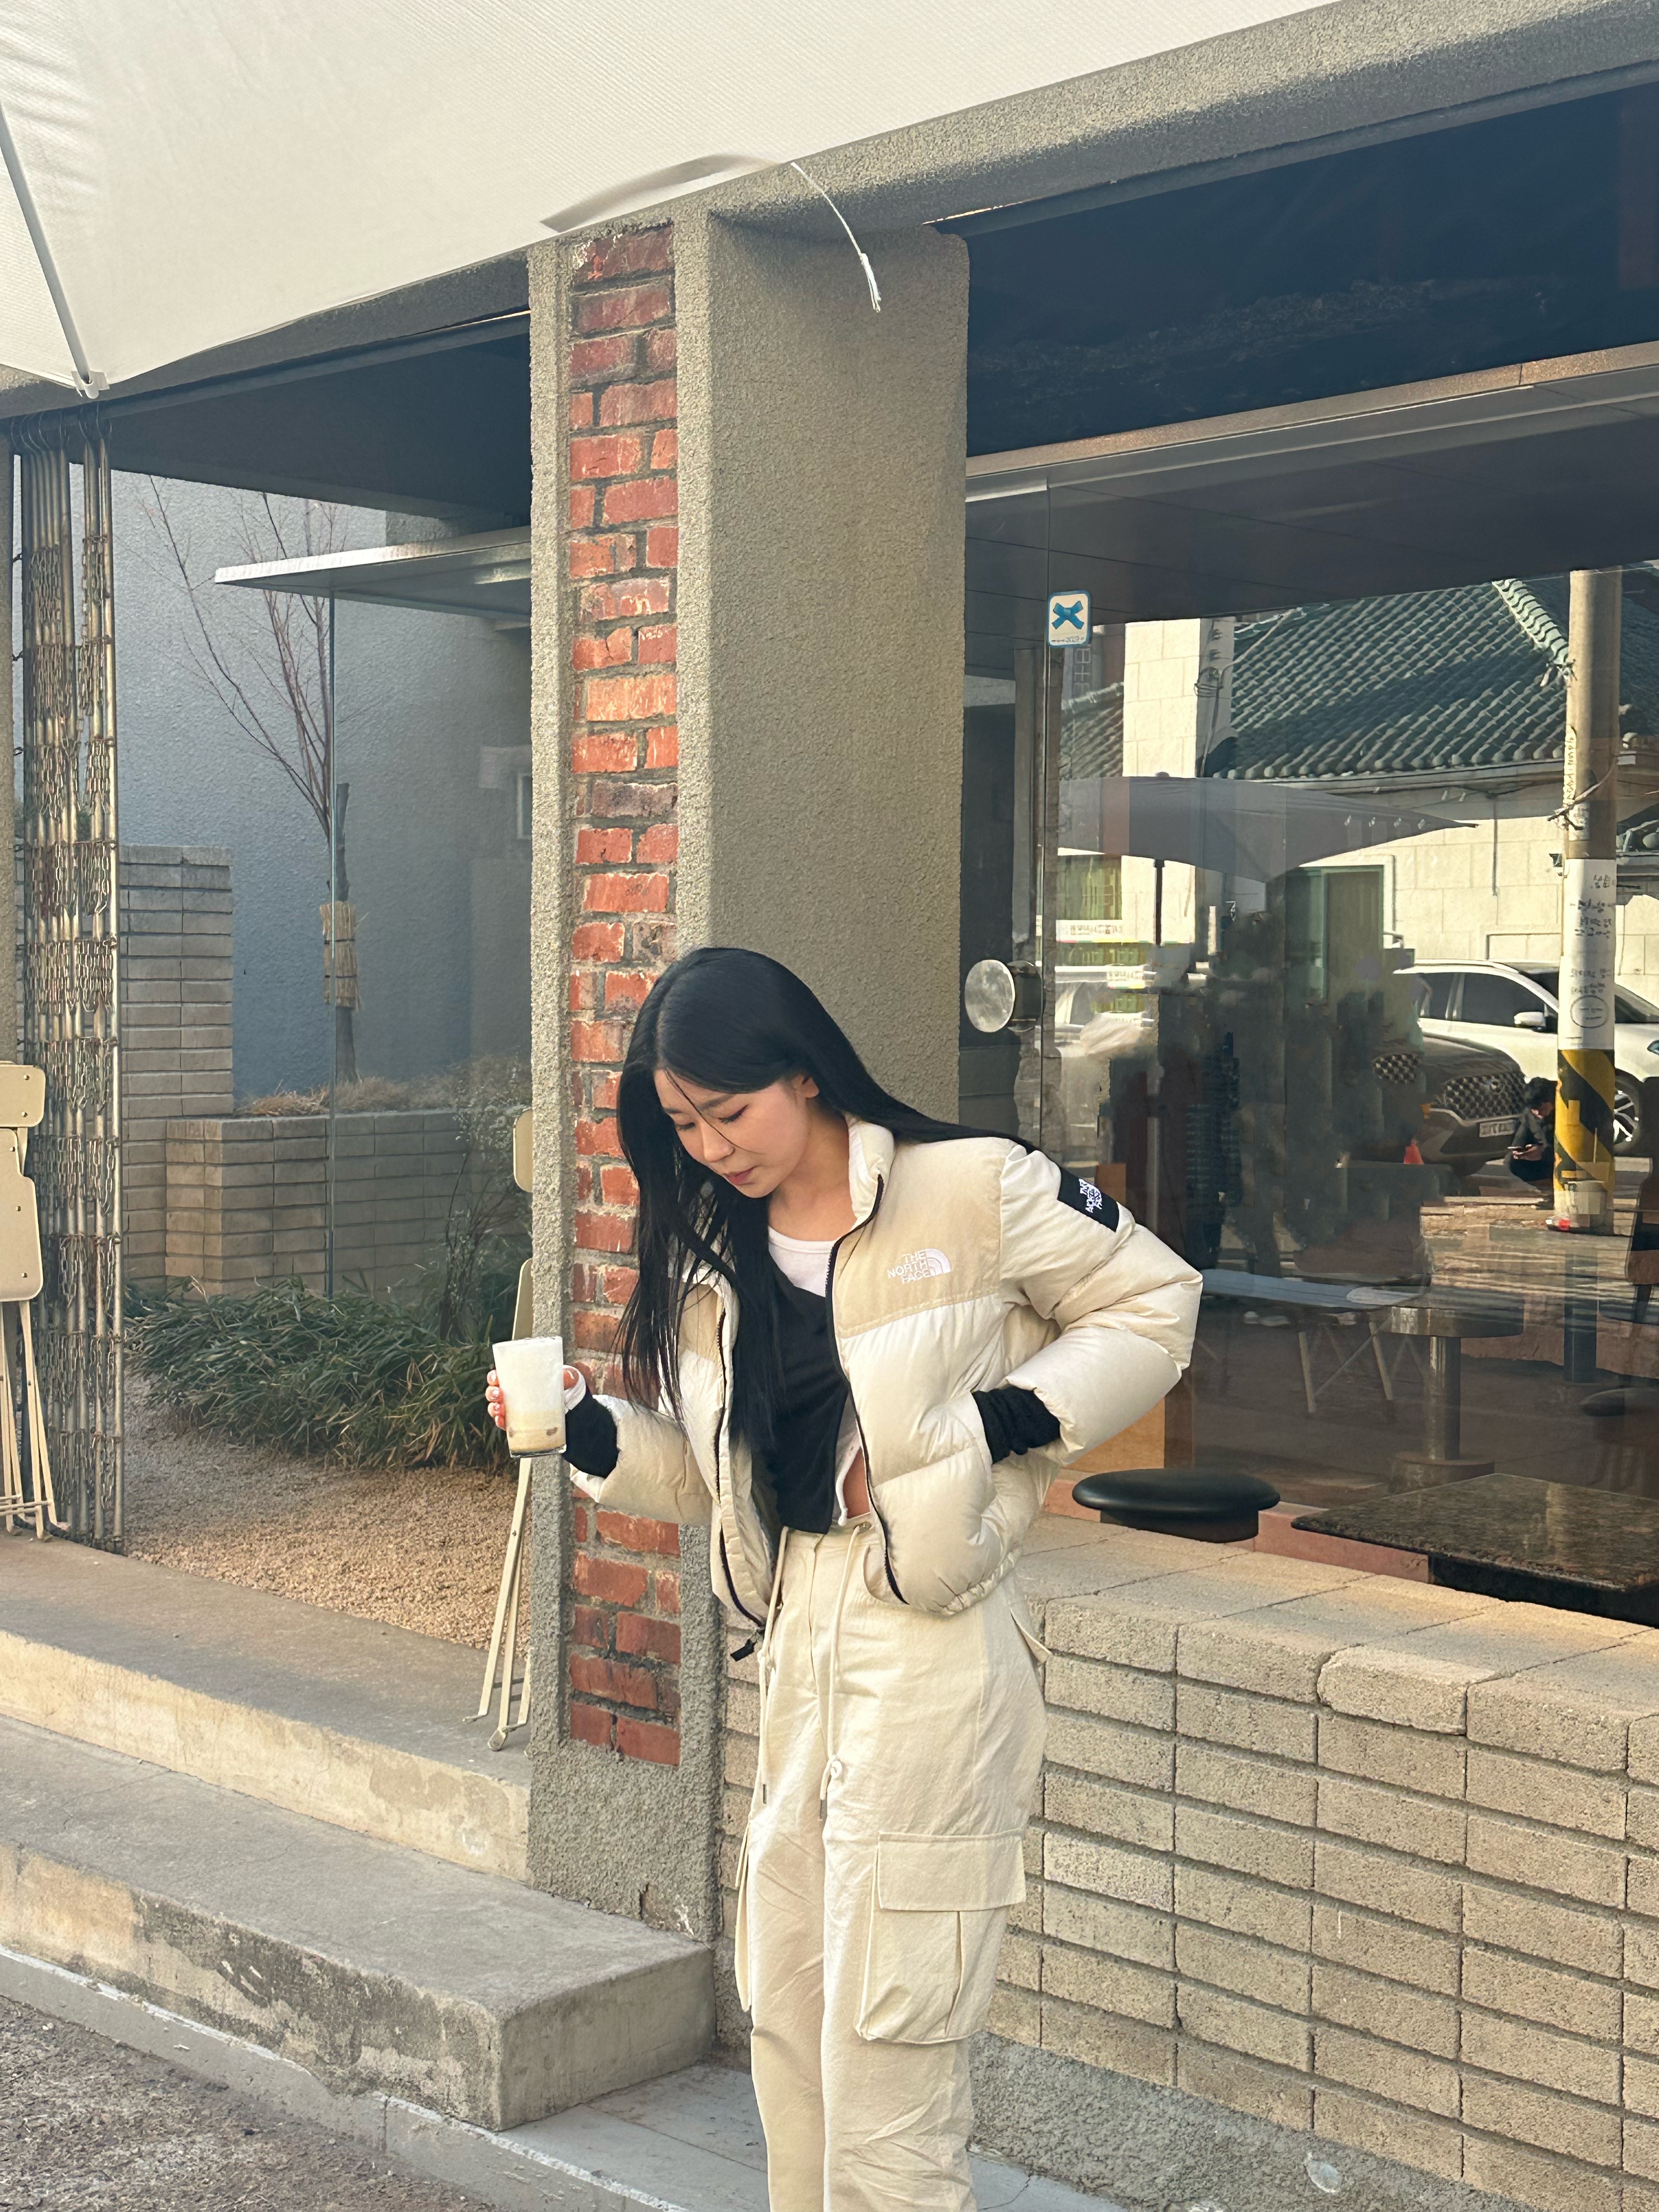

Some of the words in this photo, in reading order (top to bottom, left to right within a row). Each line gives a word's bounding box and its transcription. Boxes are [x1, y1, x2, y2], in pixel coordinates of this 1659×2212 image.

[901, 1250, 926, 1264] THE
[887, 1260, 928, 1278] NORTH
[901, 1270, 931, 1284] FACE
